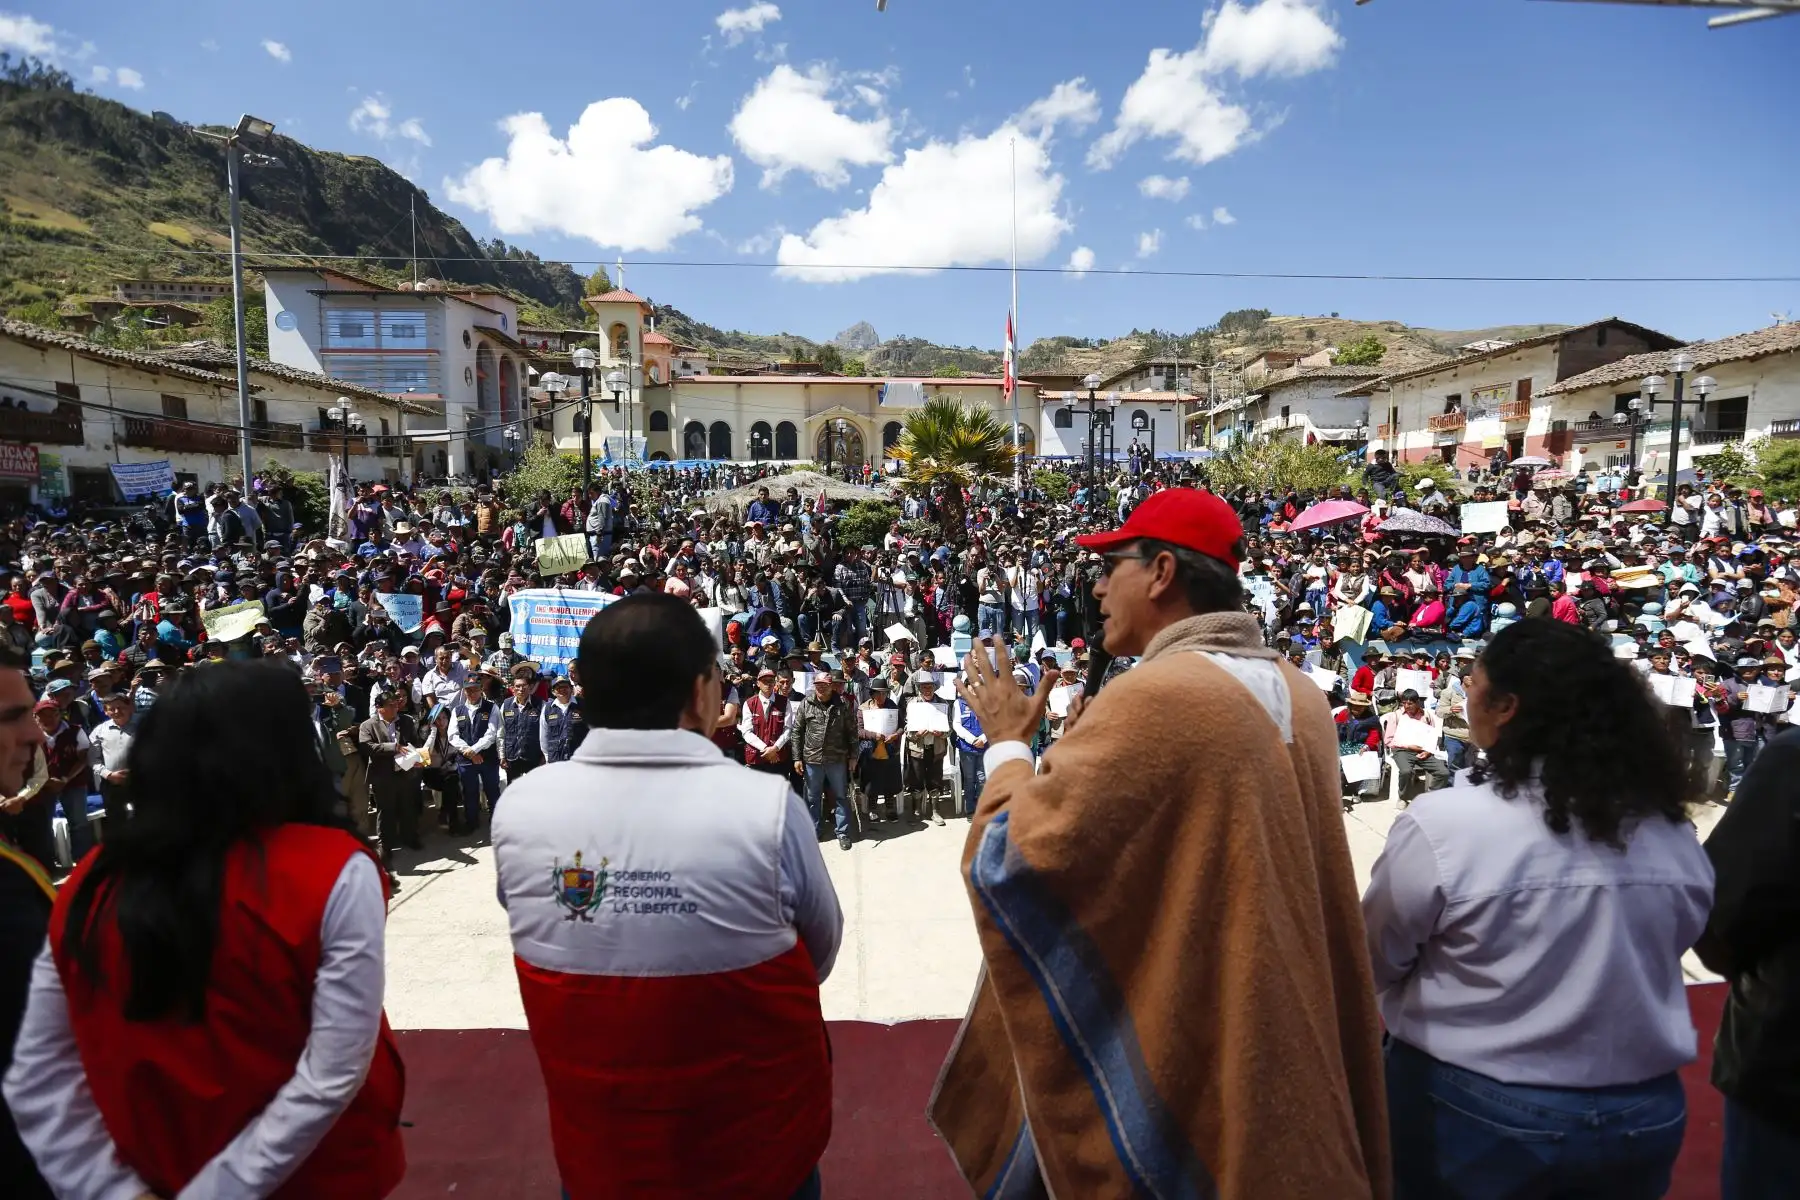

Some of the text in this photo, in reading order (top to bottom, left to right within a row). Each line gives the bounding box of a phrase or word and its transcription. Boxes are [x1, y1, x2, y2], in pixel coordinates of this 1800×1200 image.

[0, 459, 38, 472] EFANY
[549, 605, 571, 614] MANUEL
[614, 871, 671, 882] GOBIERNO
[614, 886, 682, 898] REGIONAL
[614, 902, 698, 914] LA LIBERTAD
